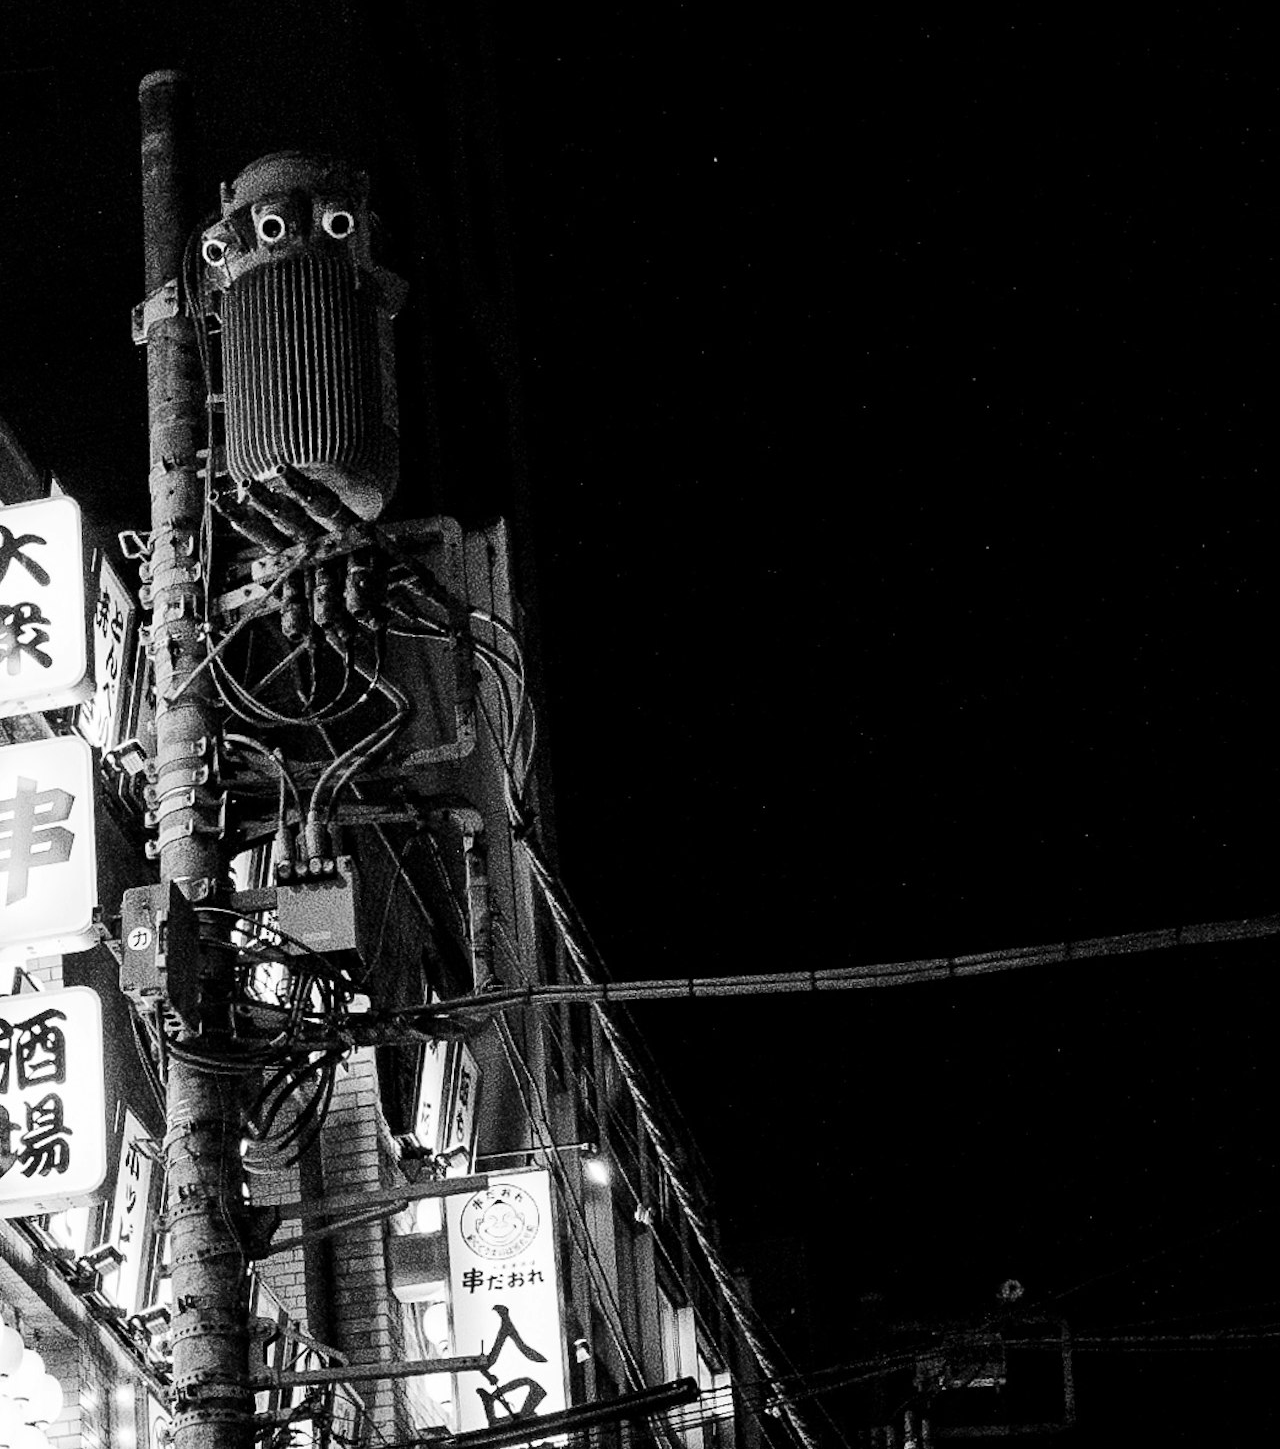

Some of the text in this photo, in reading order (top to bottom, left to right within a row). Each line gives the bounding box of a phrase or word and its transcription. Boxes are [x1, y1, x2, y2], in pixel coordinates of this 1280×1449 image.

[471, 1187, 524, 1211] 串だおれ
[462, 1267, 545, 1294] 串だおれ
